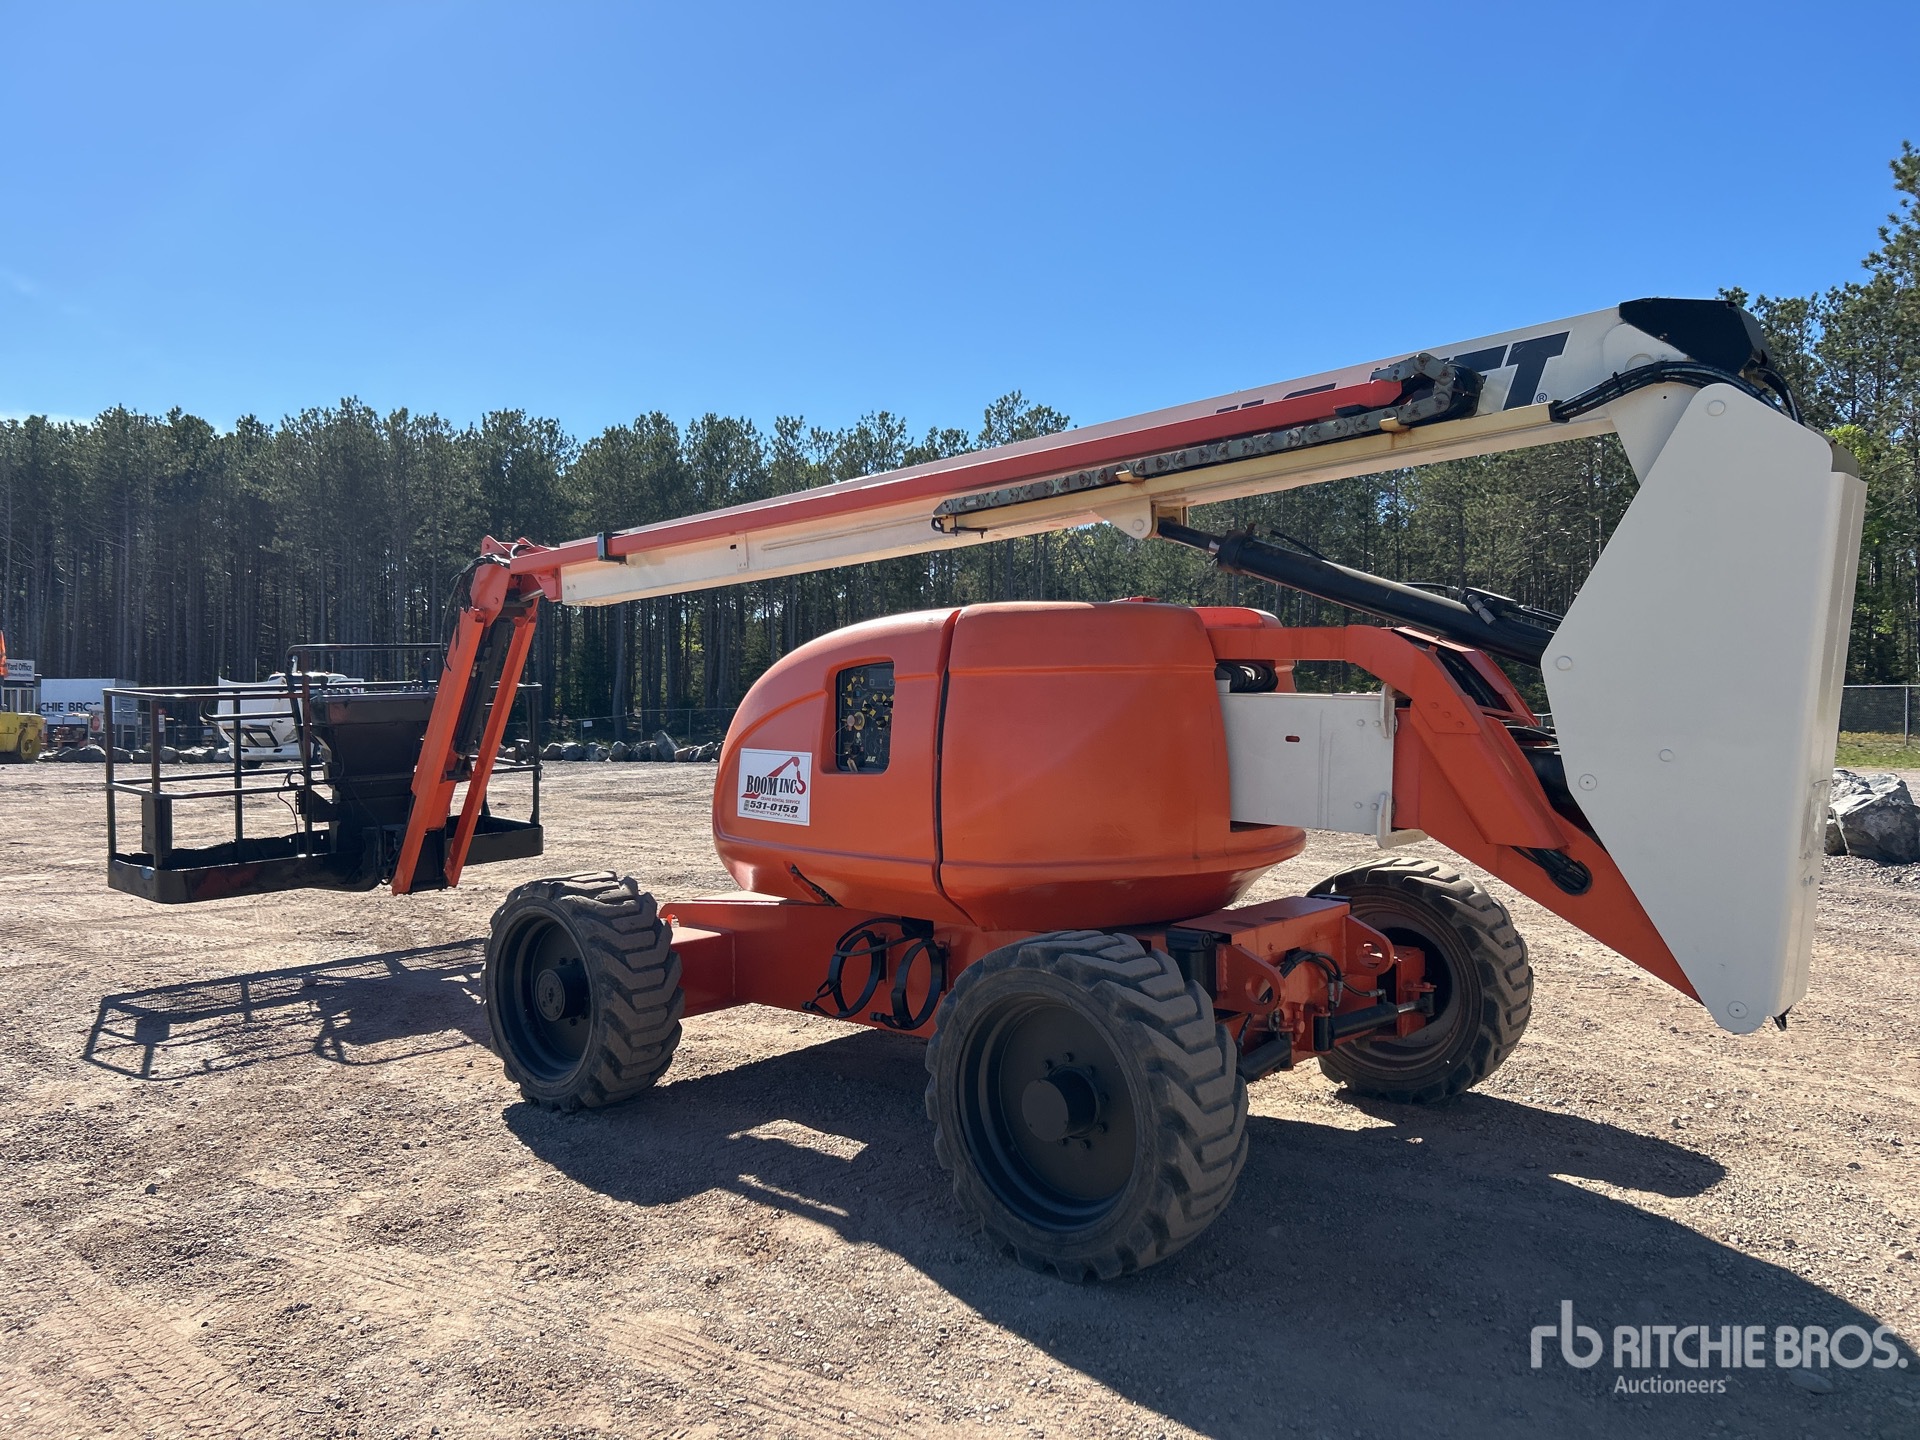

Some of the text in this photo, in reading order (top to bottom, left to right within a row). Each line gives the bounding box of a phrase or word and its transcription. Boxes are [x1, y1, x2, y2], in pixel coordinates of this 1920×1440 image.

[18, 662, 33, 672] Office
[746, 775, 797, 796] BOOM INC
[750, 800, 799, 814] 531-0159
